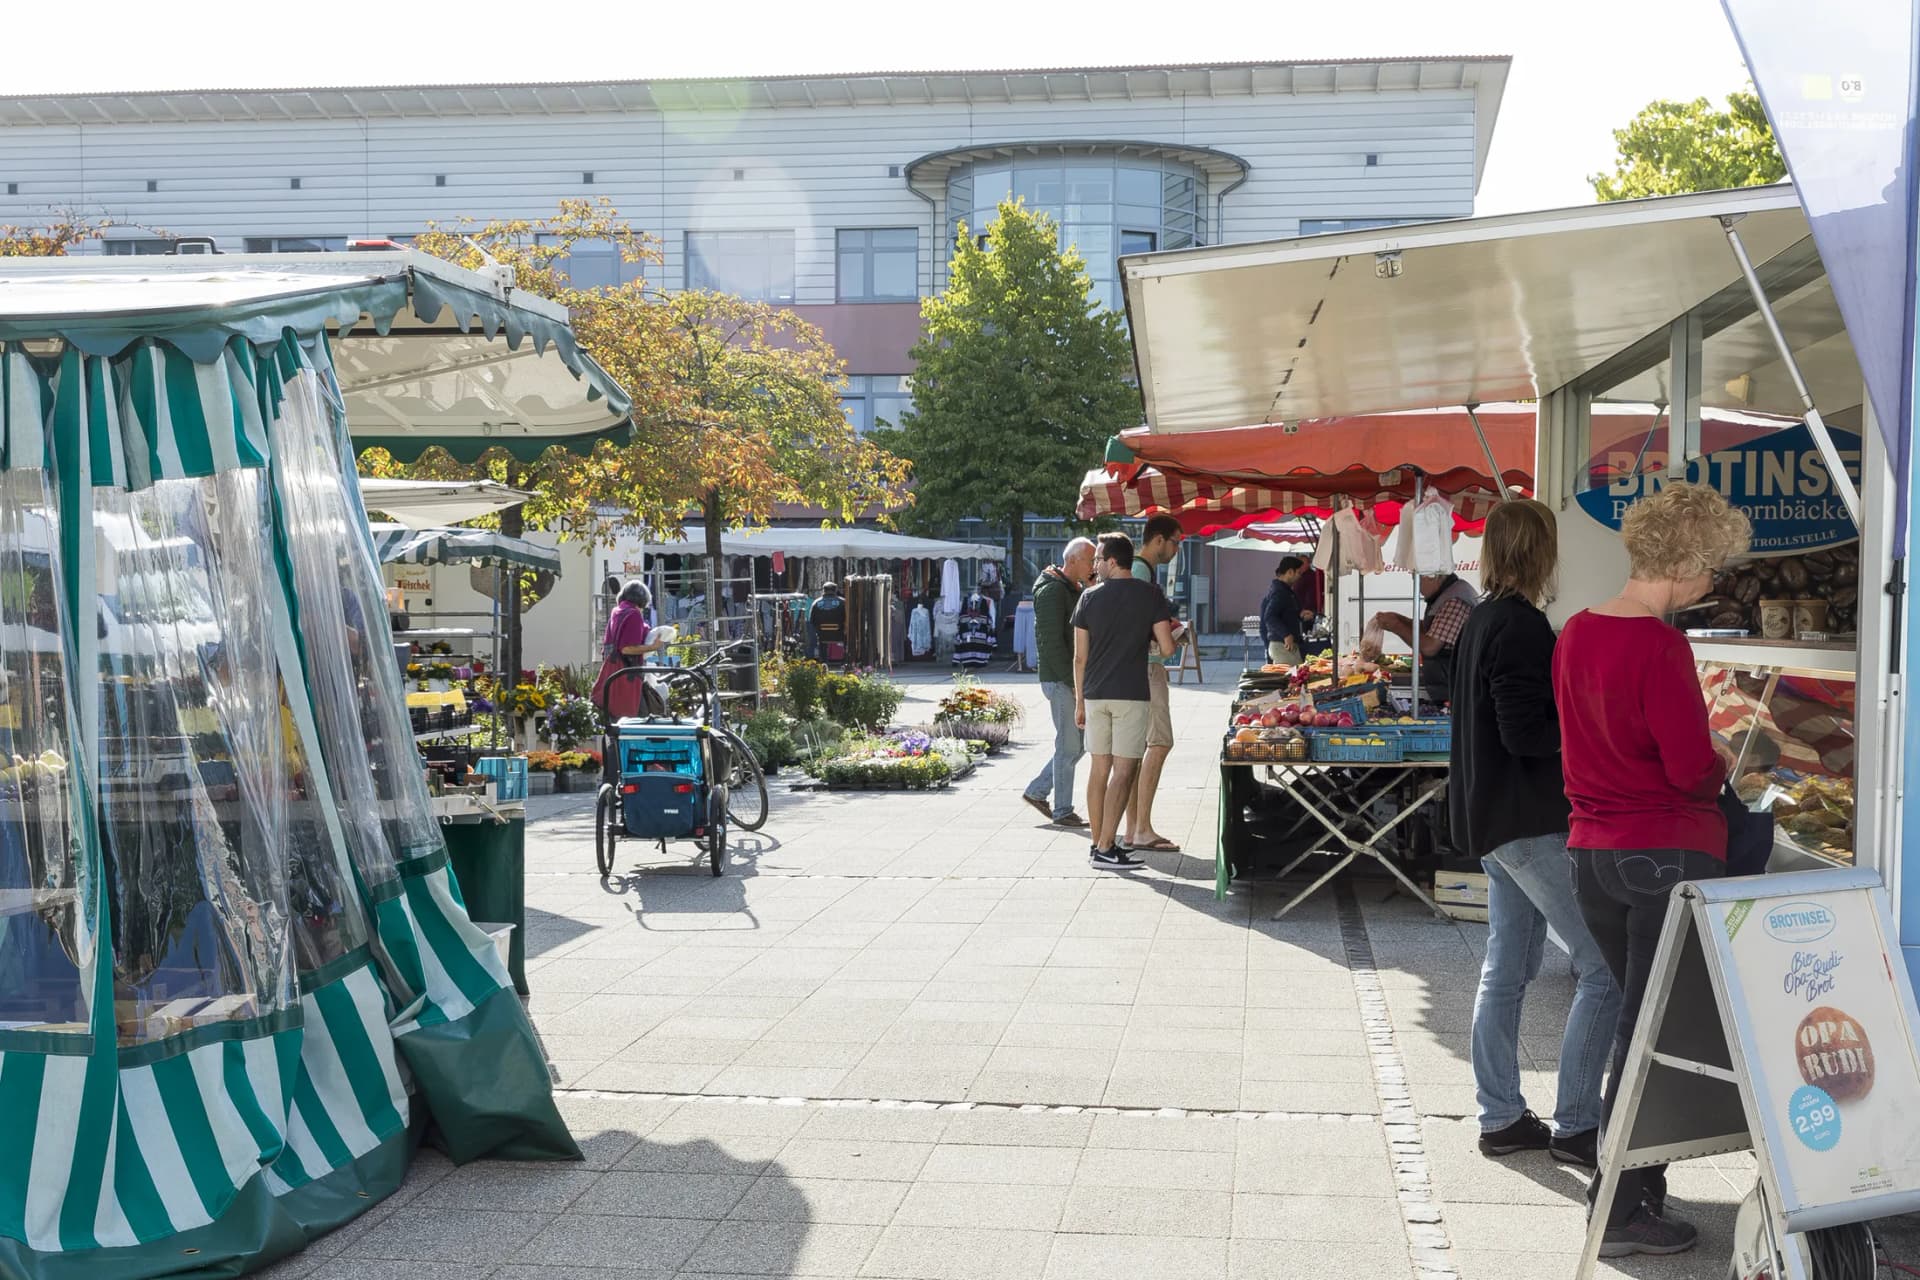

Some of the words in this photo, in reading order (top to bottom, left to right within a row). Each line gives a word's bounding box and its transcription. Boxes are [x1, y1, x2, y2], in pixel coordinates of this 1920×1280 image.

[1608, 450, 1861, 497] BROTINSE
[1742, 499, 1850, 520] ornbäcke
[1751, 530, 1837, 548] TROLLSTELLE
[1769, 910, 1831, 929] BROTINSEL
[1791, 952, 1817, 974] Bio-
[1806, 974, 1835, 1002] Brot
[1800, 1020, 1860, 1047] OPA
[1803, 1048, 1868, 1080] RUDI
[1796, 1104, 1835, 1134] 2,99
